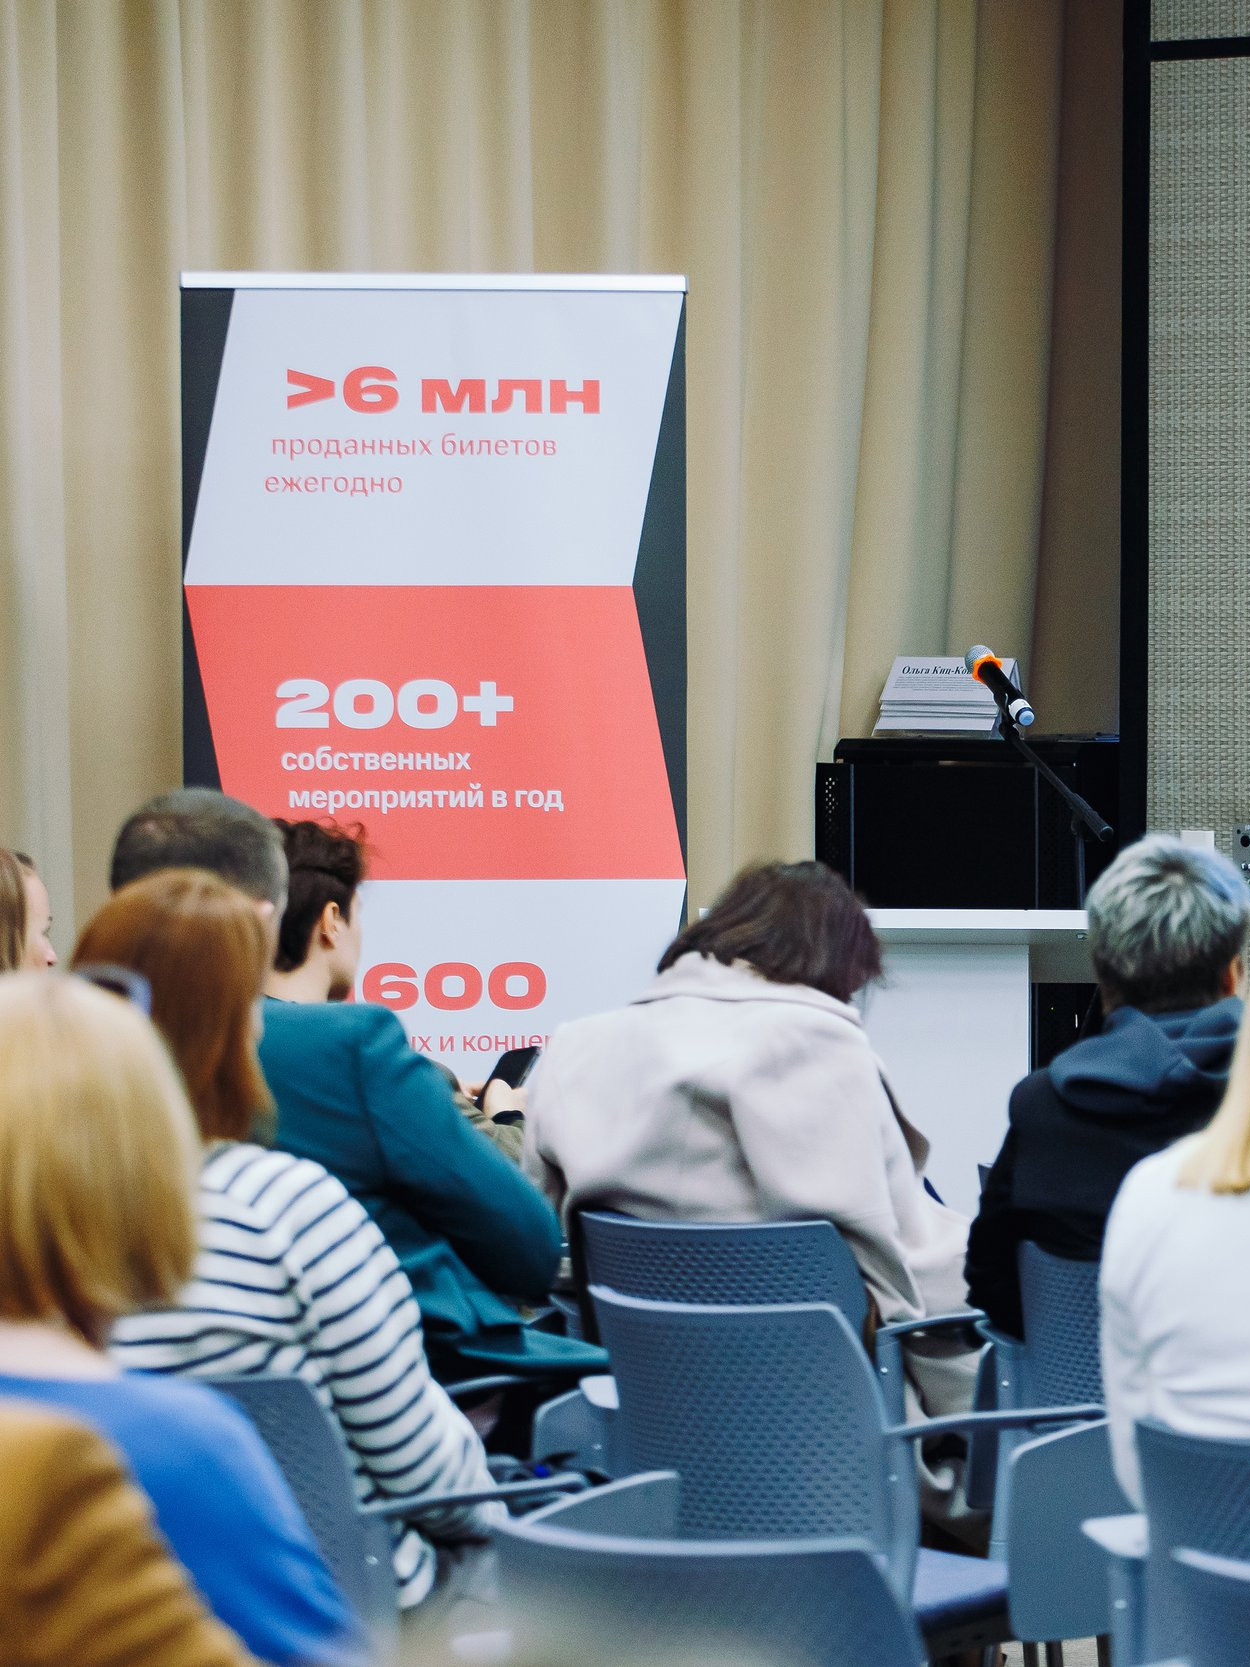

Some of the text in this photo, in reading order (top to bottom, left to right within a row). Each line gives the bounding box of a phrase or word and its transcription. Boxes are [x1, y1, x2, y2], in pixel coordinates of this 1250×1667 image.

[420, 378, 600, 414] млн
[271, 432, 557, 461] проданных билетов
[264, 475, 403, 497] ежегодно
[902, 665, 930, 675] Ольга
[275, 678, 514, 730] 200+
[280, 745, 471, 771] собственных
[288, 782, 564, 814] мероприятий в год
[347, 961, 547, 1011] 600
[439, 1035, 455, 1053] и
